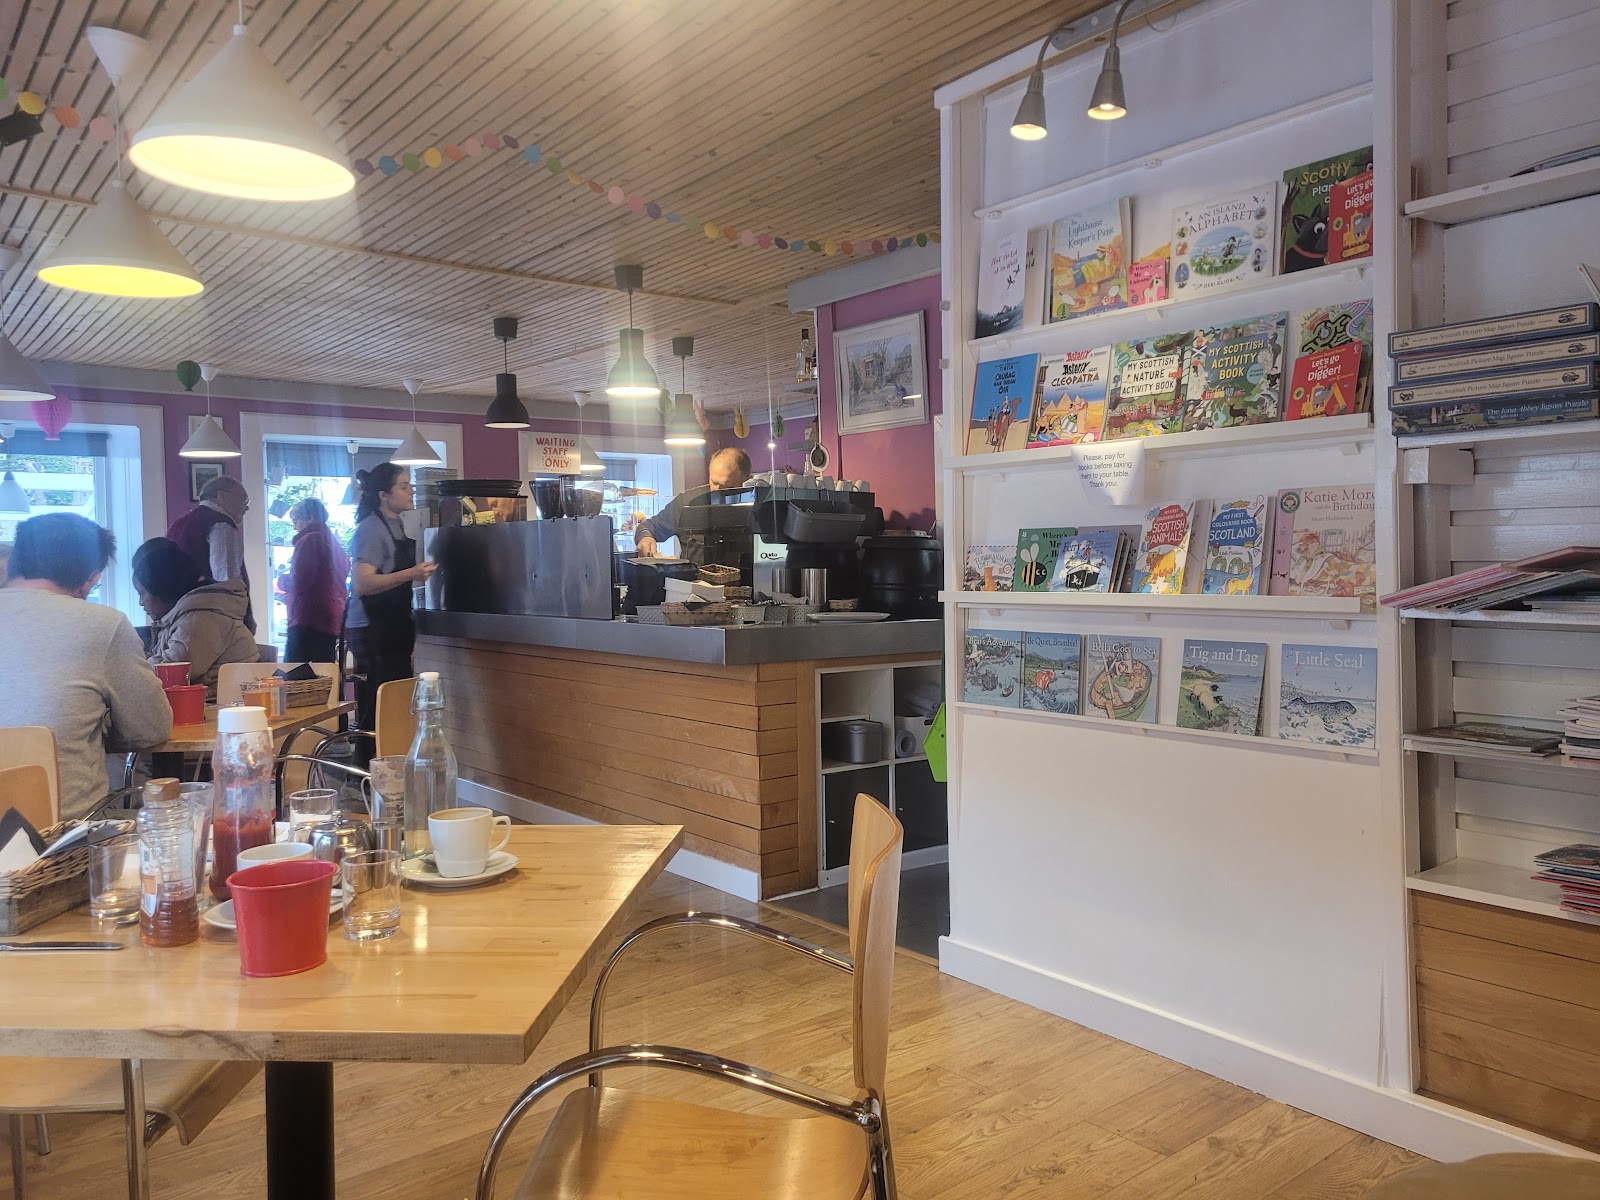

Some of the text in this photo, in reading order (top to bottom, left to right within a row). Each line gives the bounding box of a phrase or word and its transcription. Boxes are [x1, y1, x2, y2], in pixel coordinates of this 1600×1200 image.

[1300, 160, 1352, 186] Scotty
[1312, 180, 1340, 197] Pla
[1346, 182, 1364, 195] Let's
[1198, 212, 1211, 221] AN
[1213, 202, 1246, 216] ISLAND
[1068, 219, 1103, 238] Lighthouse
[1189, 210, 1255, 236] ALPHABET
[1068, 226, 1115, 250] Keeper's Picnic
[1217, 278, 1236, 287] GLIORI
[1438, 331, 1462, 341] Scottish
[1461, 327, 1483, 337] Picture
[1483, 325, 1497, 334] Map
[1496, 322, 1515, 332] Jigsaw
[1516, 319, 1536, 328] Puzzle
[1208, 339, 1264, 357] MY SCOTTISH
[1127, 362, 1138, 372] MY
[1139, 356, 1175, 369] SCOTTISH
[1211, 352, 1257, 369] ACTIVITY
[1312, 355, 1340, 368] Let's go
[1446, 359, 1470, 368] Scottish
[1470, 356, 1492, 366] Picture
[1492, 353, 1506, 362] Map
[1506, 351, 1525, 361] Jigsaw
[1525, 348, 1546, 357] Puzzle
[1051, 372, 1099, 387] CLEOPATRA
[1133, 369, 1165, 383] NATURE
[1219, 366, 1245, 380] BOOK
[1308, 365, 1341, 381] Digger!
[1122, 380, 1174, 395] ACTIVITY BOOK
[1443, 387, 1466, 396] Scottish
[1466, 384, 1488, 393] Picture
[1487, 381, 1501, 391] Map
[1501, 379, 1520, 389] Jigsaw
[1521, 377, 1542, 386] Puzzle
[1485, 399, 1590, 417] The Iona Abbey Jigsaw Puzzle
[536, 437, 577, 447] WAITING
[543, 447, 569, 455] STAFF
[545, 457, 569, 468] ONLY
[1094, 462, 1113, 470] before
[1113, 461, 1133, 469] taking
[1099, 472, 1112, 480] your
[1303, 490, 1338, 503] Katie
[1333, 500, 1375, 512] Birthday
[1230, 511, 1245, 519] FIRST
[1152, 518, 1186, 534] SCOTTISH
[1211, 518, 1254, 529] COLOURING BOOK
[1150, 530, 1184, 544] ANIMALS
[1209, 526, 1256, 542] SCOTLAND
[1063, 541, 1082, 554] Ferry
[986, 638, 1019, 648] Adventure
[1027, 636, 1035, 645] Be
[1053, 638, 1078, 648] Bramble!
[1092, 642, 1157, 655] Bella Goes to Sea
[1189, 645, 1259, 667] Tig and Tag
[1294, 651, 1330, 667] Little
[1332, 653, 1364, 669] Seal
